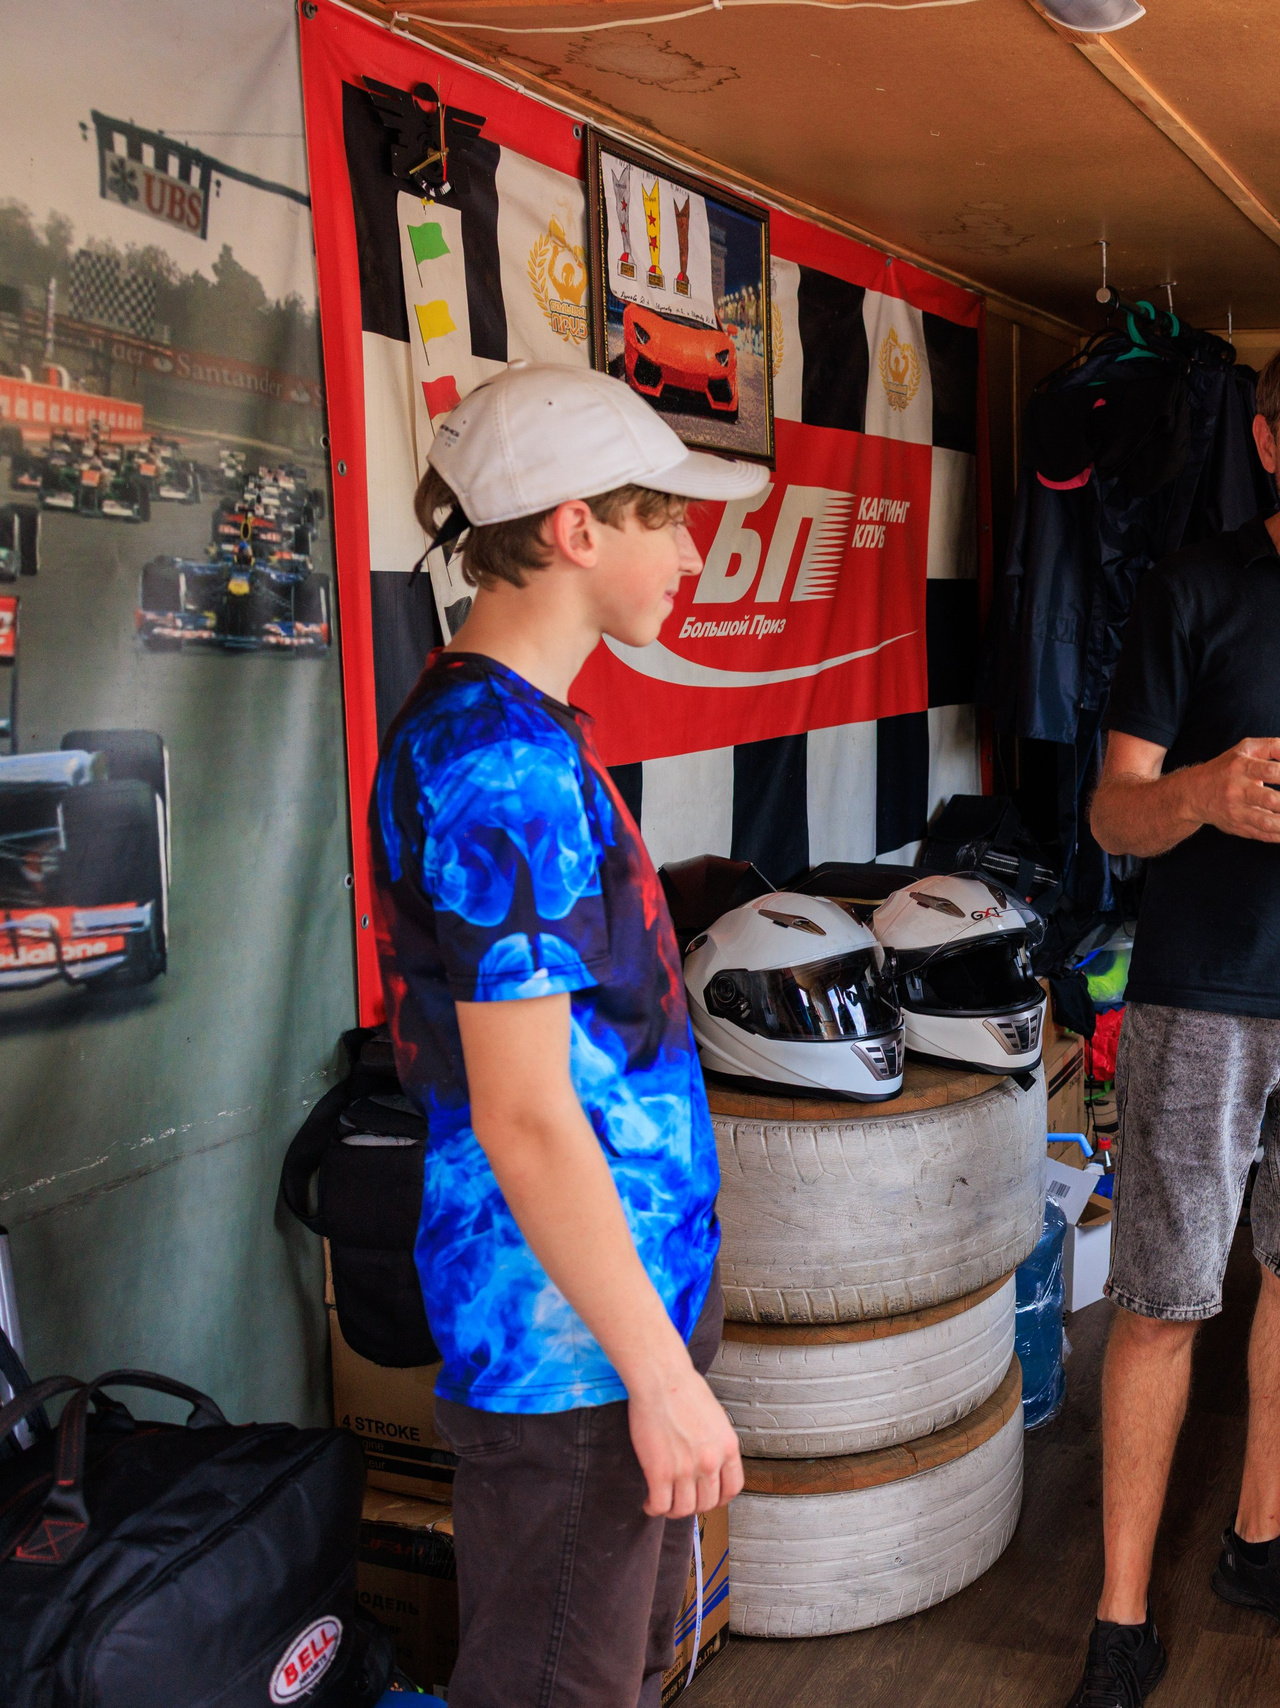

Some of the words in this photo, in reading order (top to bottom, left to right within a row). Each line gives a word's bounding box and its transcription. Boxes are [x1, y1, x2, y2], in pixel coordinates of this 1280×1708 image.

[142, 171, 201, 231] UBS
[552, 313, 588, 339] ПРИЗ
[176, 356, 283, 394] Santander
[858, 497, 910, 524] КАРТИНГ
[692, 482, 856, 604] БП
[852, 524, 886, 548] КЛУБ
[678, 616, 750, 638] Большой
[750, 614, 786, 640] Приз
[970, 906, 1002, 922] GXT
[343, 1414, 351, 1427] 4
[355, 1417, 420, 1442] STROKE
[362, 1440, 384, 1452] gine
[369, 1460, 385, 1470] eur
[284, 1628, 334, 1687] BELL
